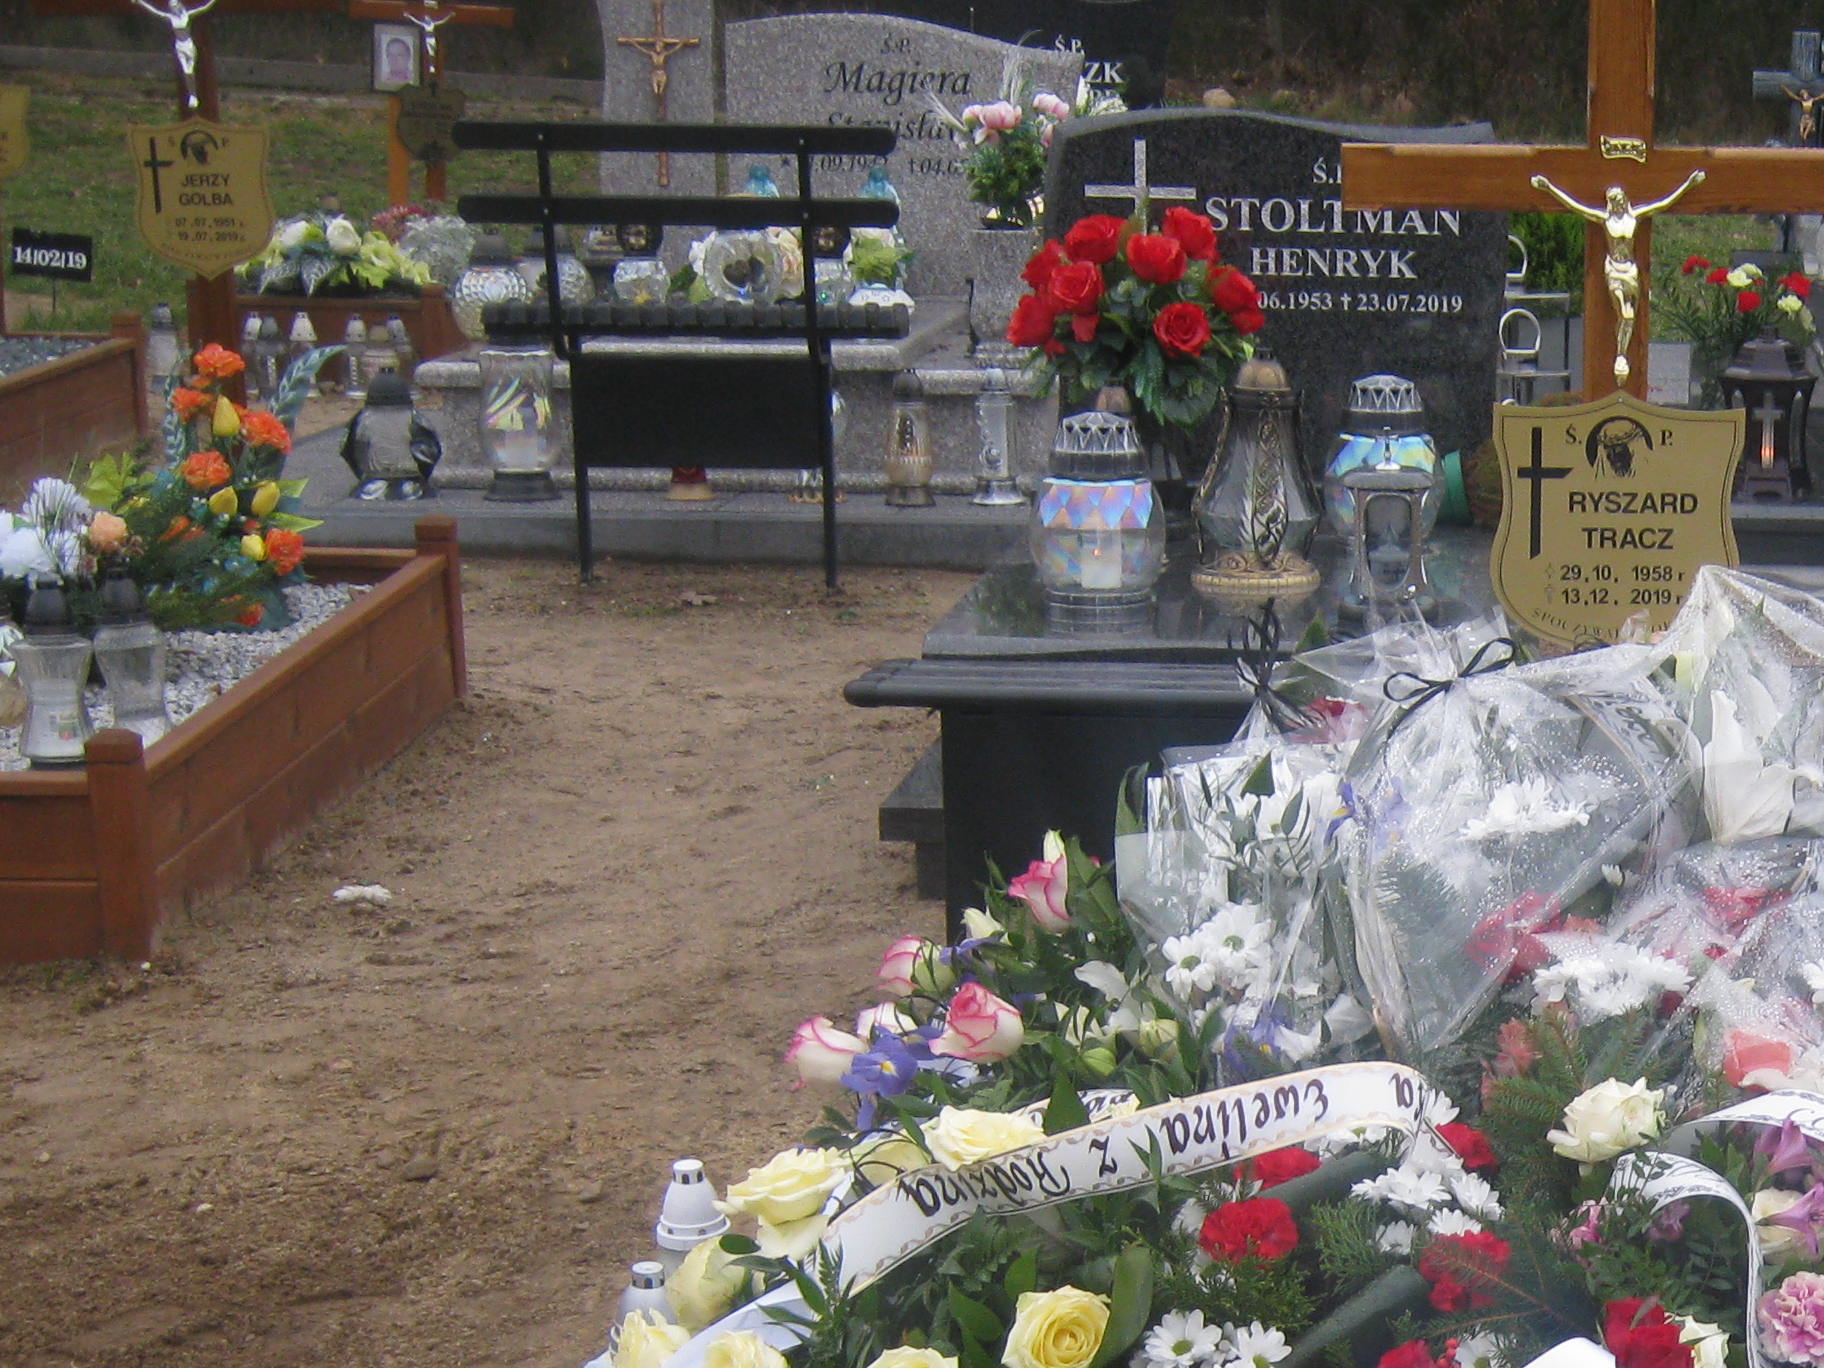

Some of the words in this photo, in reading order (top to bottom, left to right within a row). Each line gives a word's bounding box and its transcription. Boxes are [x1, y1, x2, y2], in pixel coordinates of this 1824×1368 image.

[824, 60, 972, 106] Magiera
[181, 173, 230, 188] JERZY
[1204, 196, 1461, 237] STOLTMAN
[14, 247, 87, 270] 14/02/19
[1250, 246, 1418, 280] HENRYK
[1356, 292, 1463, 313] 23.07.2019
[1568, 491, 1699, 514] RYSZARD
[1581, 527, 1675, 551] TRACZ
[1161, 1078, 1329, 1160] Ewelina
[900, 1150, 1071, 1217] Rodzina
